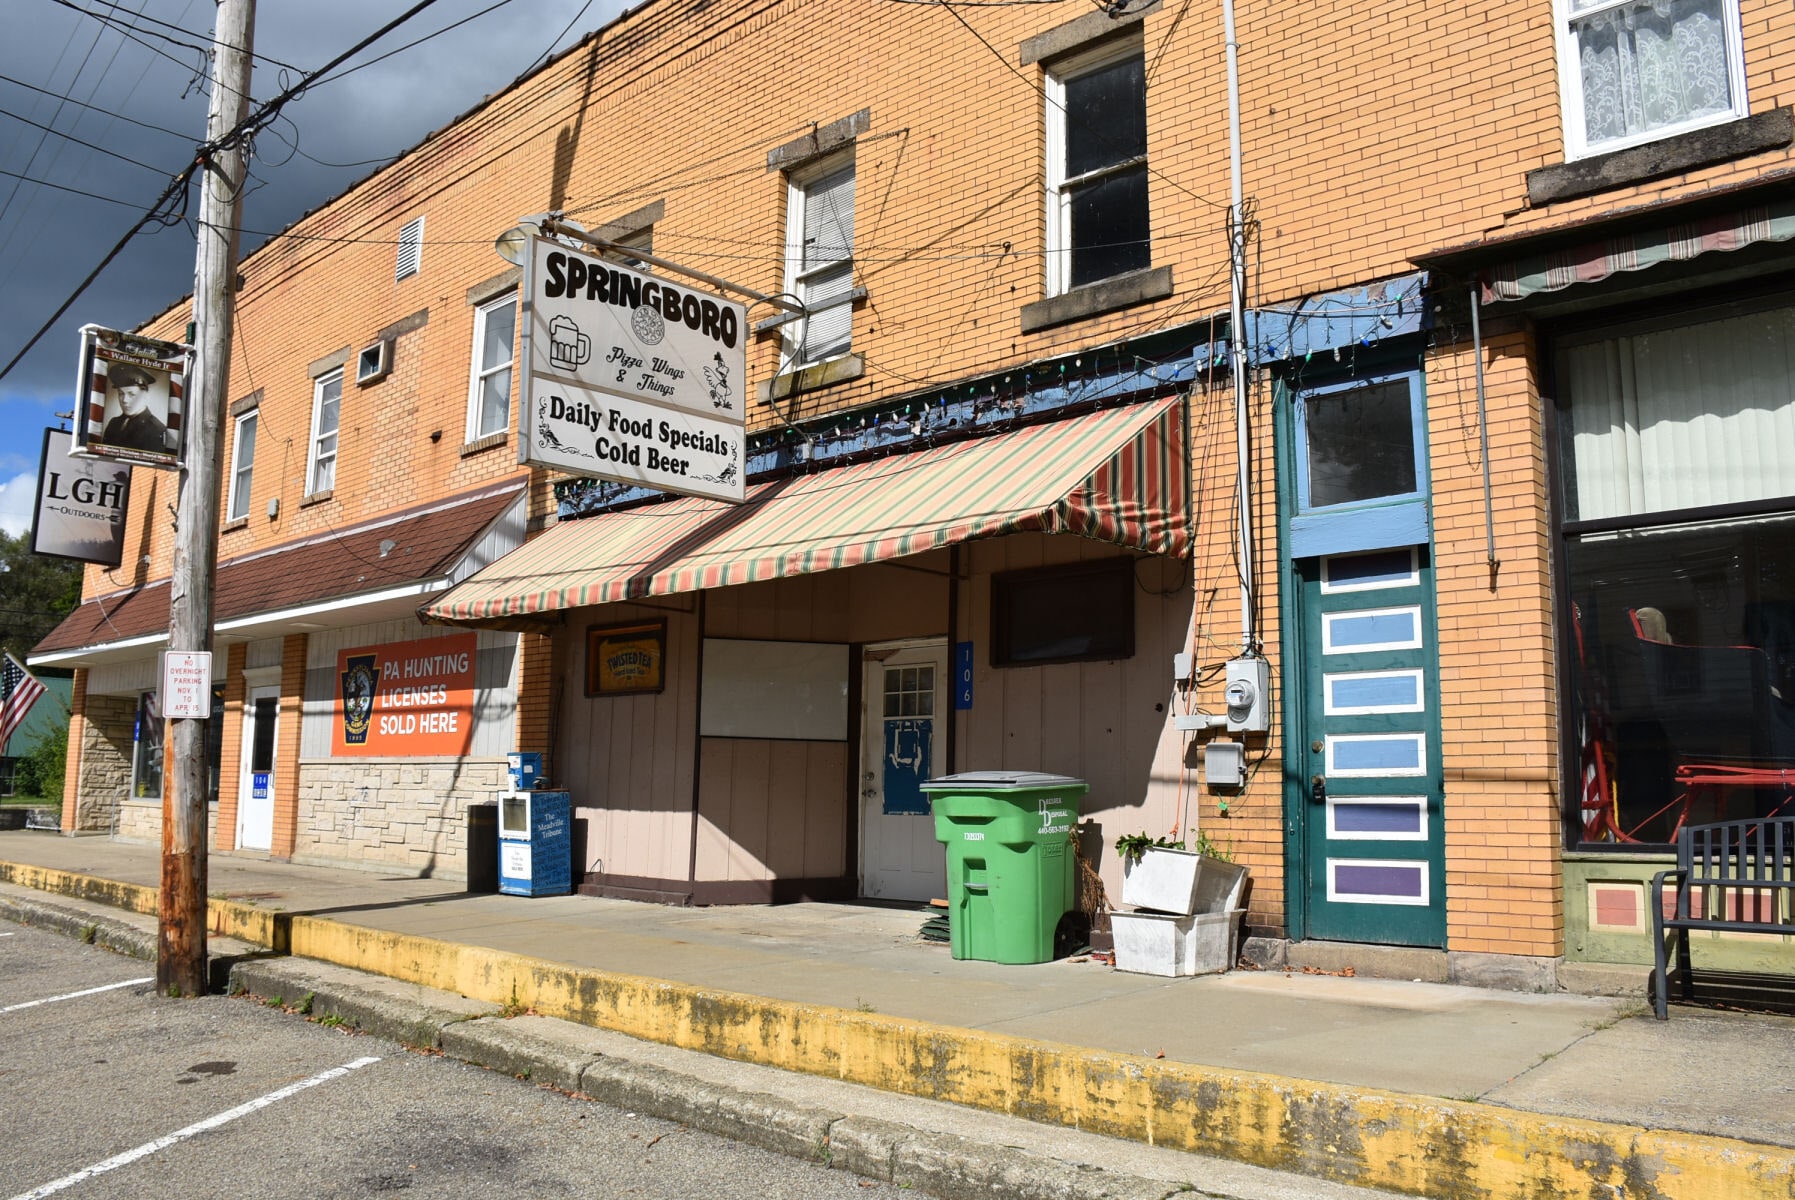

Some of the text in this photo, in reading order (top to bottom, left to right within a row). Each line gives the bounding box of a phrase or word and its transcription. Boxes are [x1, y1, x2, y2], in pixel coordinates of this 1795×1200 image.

[545, 252, 737, 349] SPRINGBORO
[111, 352, 140, 365] Wallace
[141, 358, 162, 368] Hyde
[606, 346, 685, 380] Pizza Wings
[616, 369, 675, 396] & Things
[550, 396, 728, 456] Daily Food Specials
[595, 437, 689, 476] Cold Beer
[46, 472, 124, 510] LGH
[384, 662, 400, 680] PA
[404, 653, 469, 679] HUNTING
[382, 684, 447, 708] LICENSES
[380, 714, 416, 735] SOLD
[420, 712, 458, 734] HERE
[541, 829, 562, 839] Tribune
